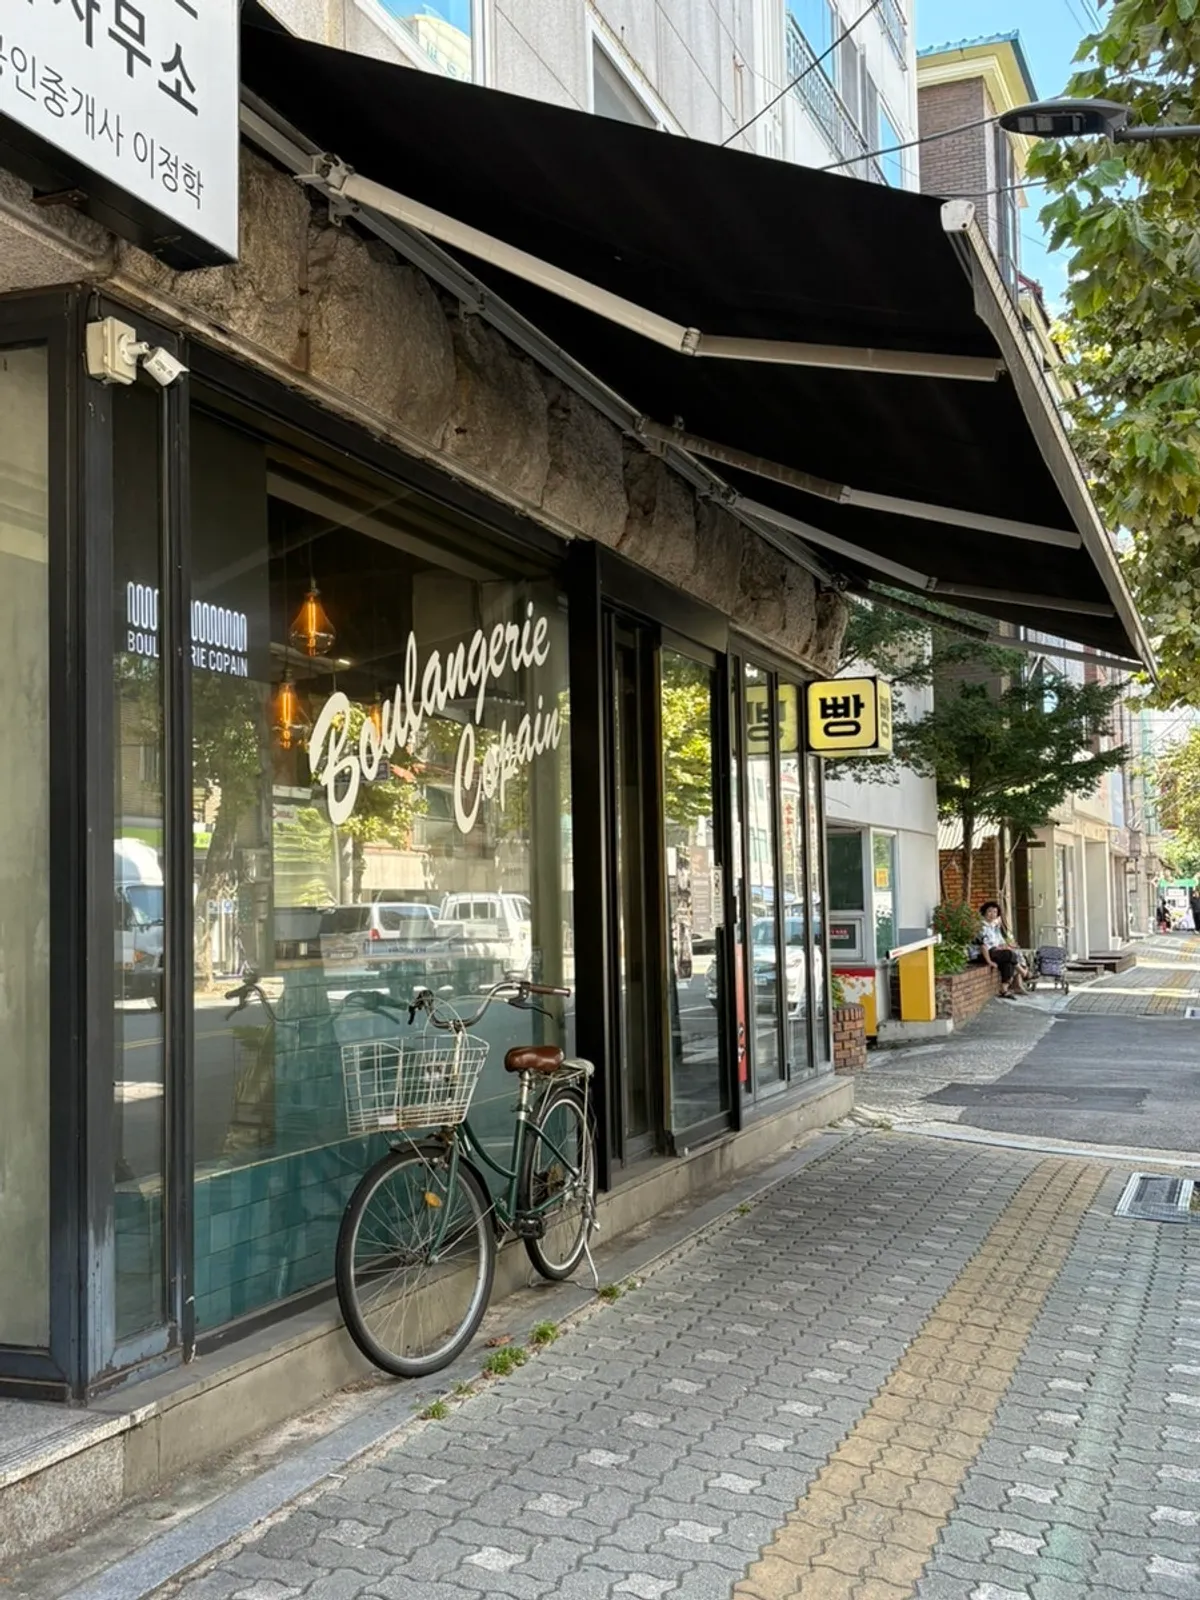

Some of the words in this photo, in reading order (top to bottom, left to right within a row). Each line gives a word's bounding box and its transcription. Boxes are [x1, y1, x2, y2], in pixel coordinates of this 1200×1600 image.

[26, 0, 199, 117] 사무소
[132, 131, 204, 210] 이정학
[208, 650, 248, 677] COPAIN
[308, 600, 551, 826] Boulangerie
[819, 693, 865, 738] 빵
[454, 694, 562, 835] Copain
